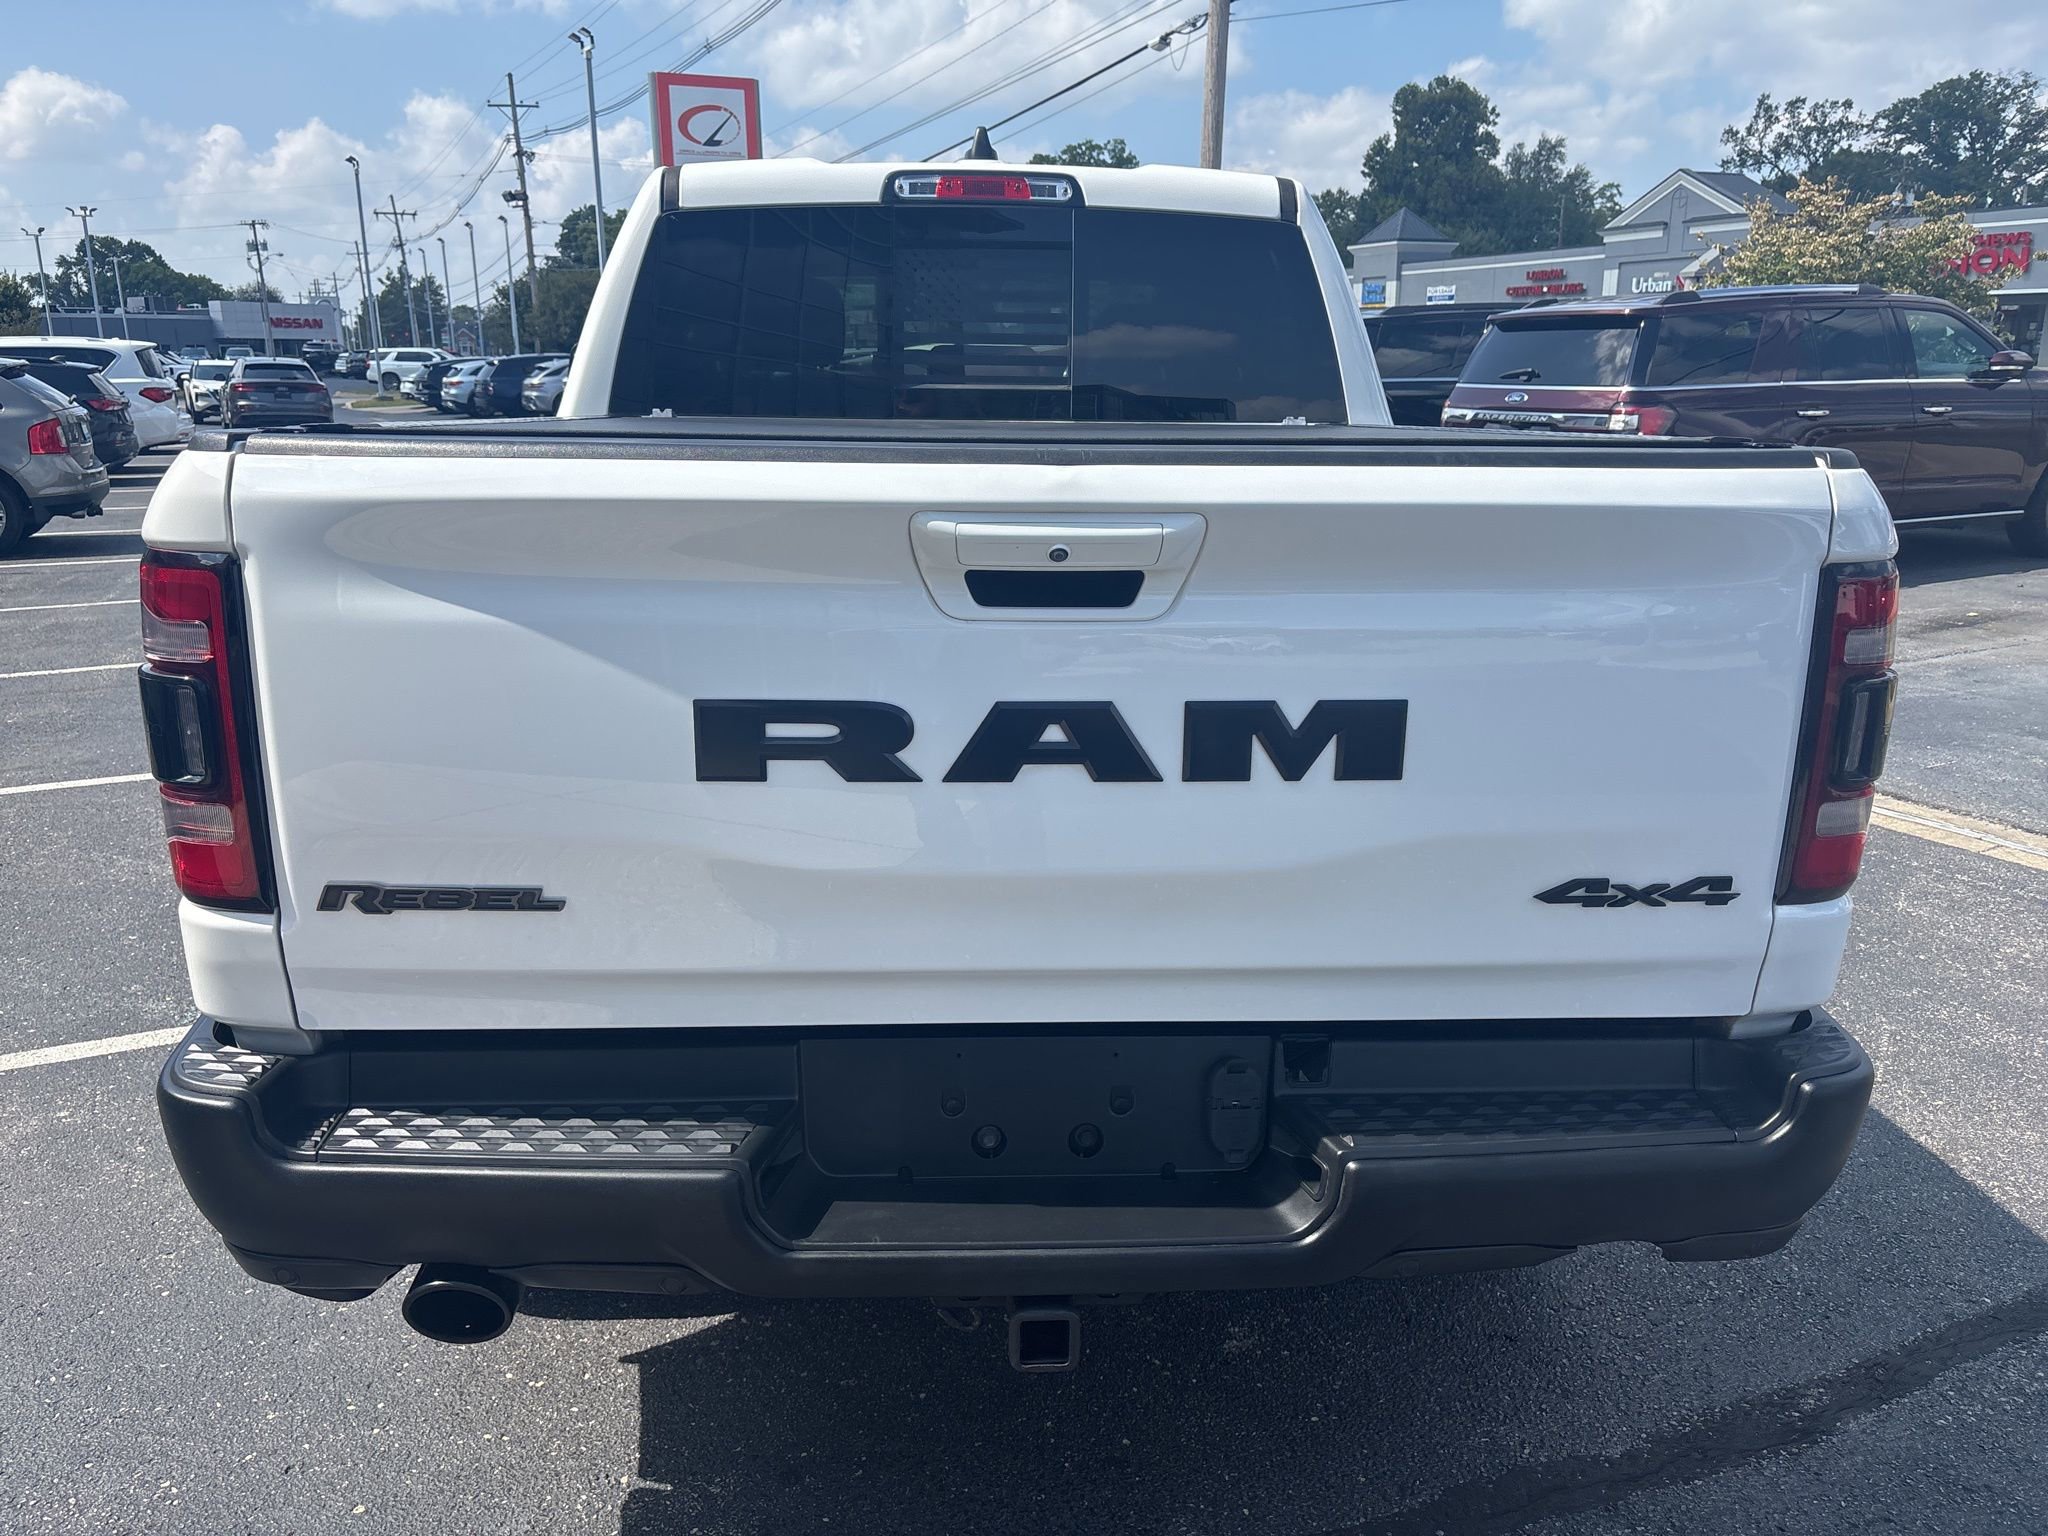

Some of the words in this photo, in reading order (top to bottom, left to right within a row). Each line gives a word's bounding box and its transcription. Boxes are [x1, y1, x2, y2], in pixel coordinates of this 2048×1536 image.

[1631, 276, 1673, 294] Urban
[269, 316, 323, 329] NISSAN
[1476, 412, 1549, 422] EXPEDITION
[693, 699, 1409, 783] RAM
[316, 882, 567, 915] REBEL
